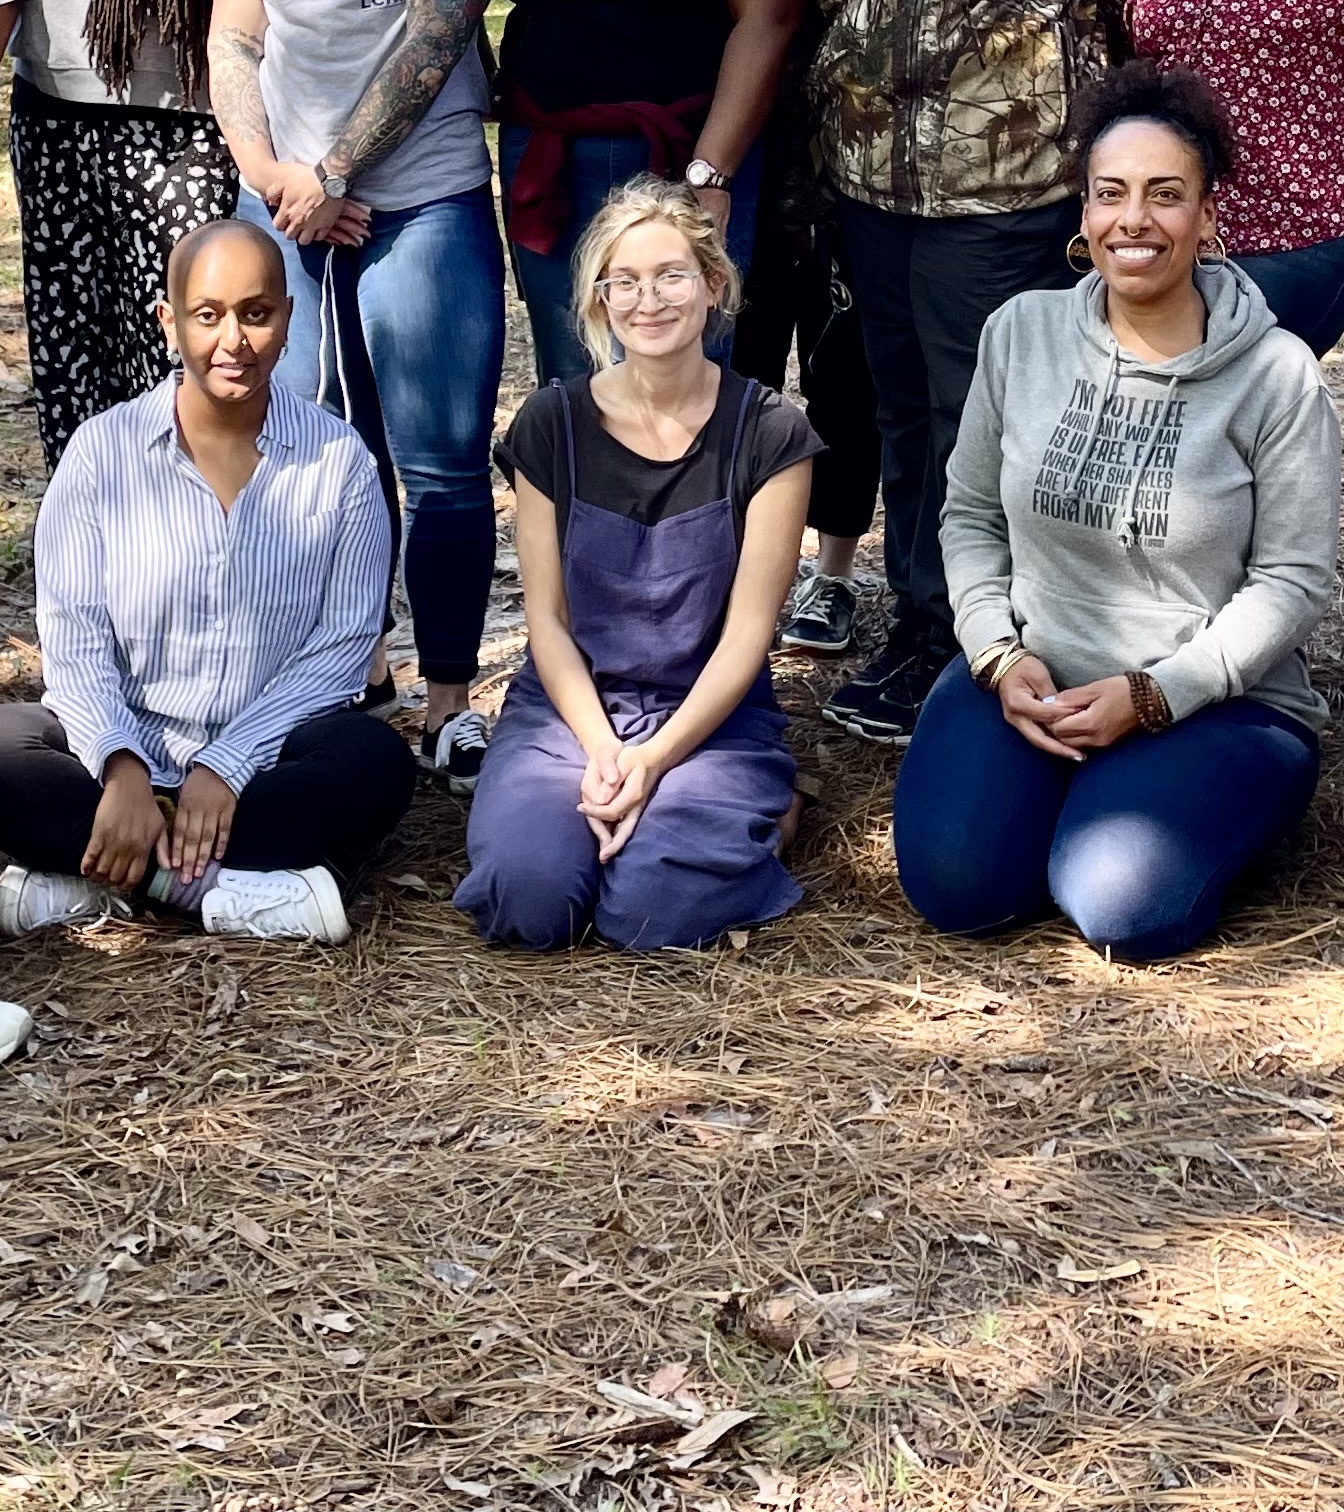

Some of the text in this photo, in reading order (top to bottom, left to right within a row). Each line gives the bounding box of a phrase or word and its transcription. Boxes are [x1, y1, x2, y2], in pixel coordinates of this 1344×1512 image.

[1068, 378, 1098, 412] I'M
[1048, 425, 1069, 448] IS
[1097, 417, 1123, 438] ANY
[1042, 448, 1173, 489] WHEN HER SHAKLES
[1035, 468, 1171, 511] ARE VRY DIFFRENT
[1084, 502, 1117, 530] MY
[1123, 509, 1169, 537] WN
